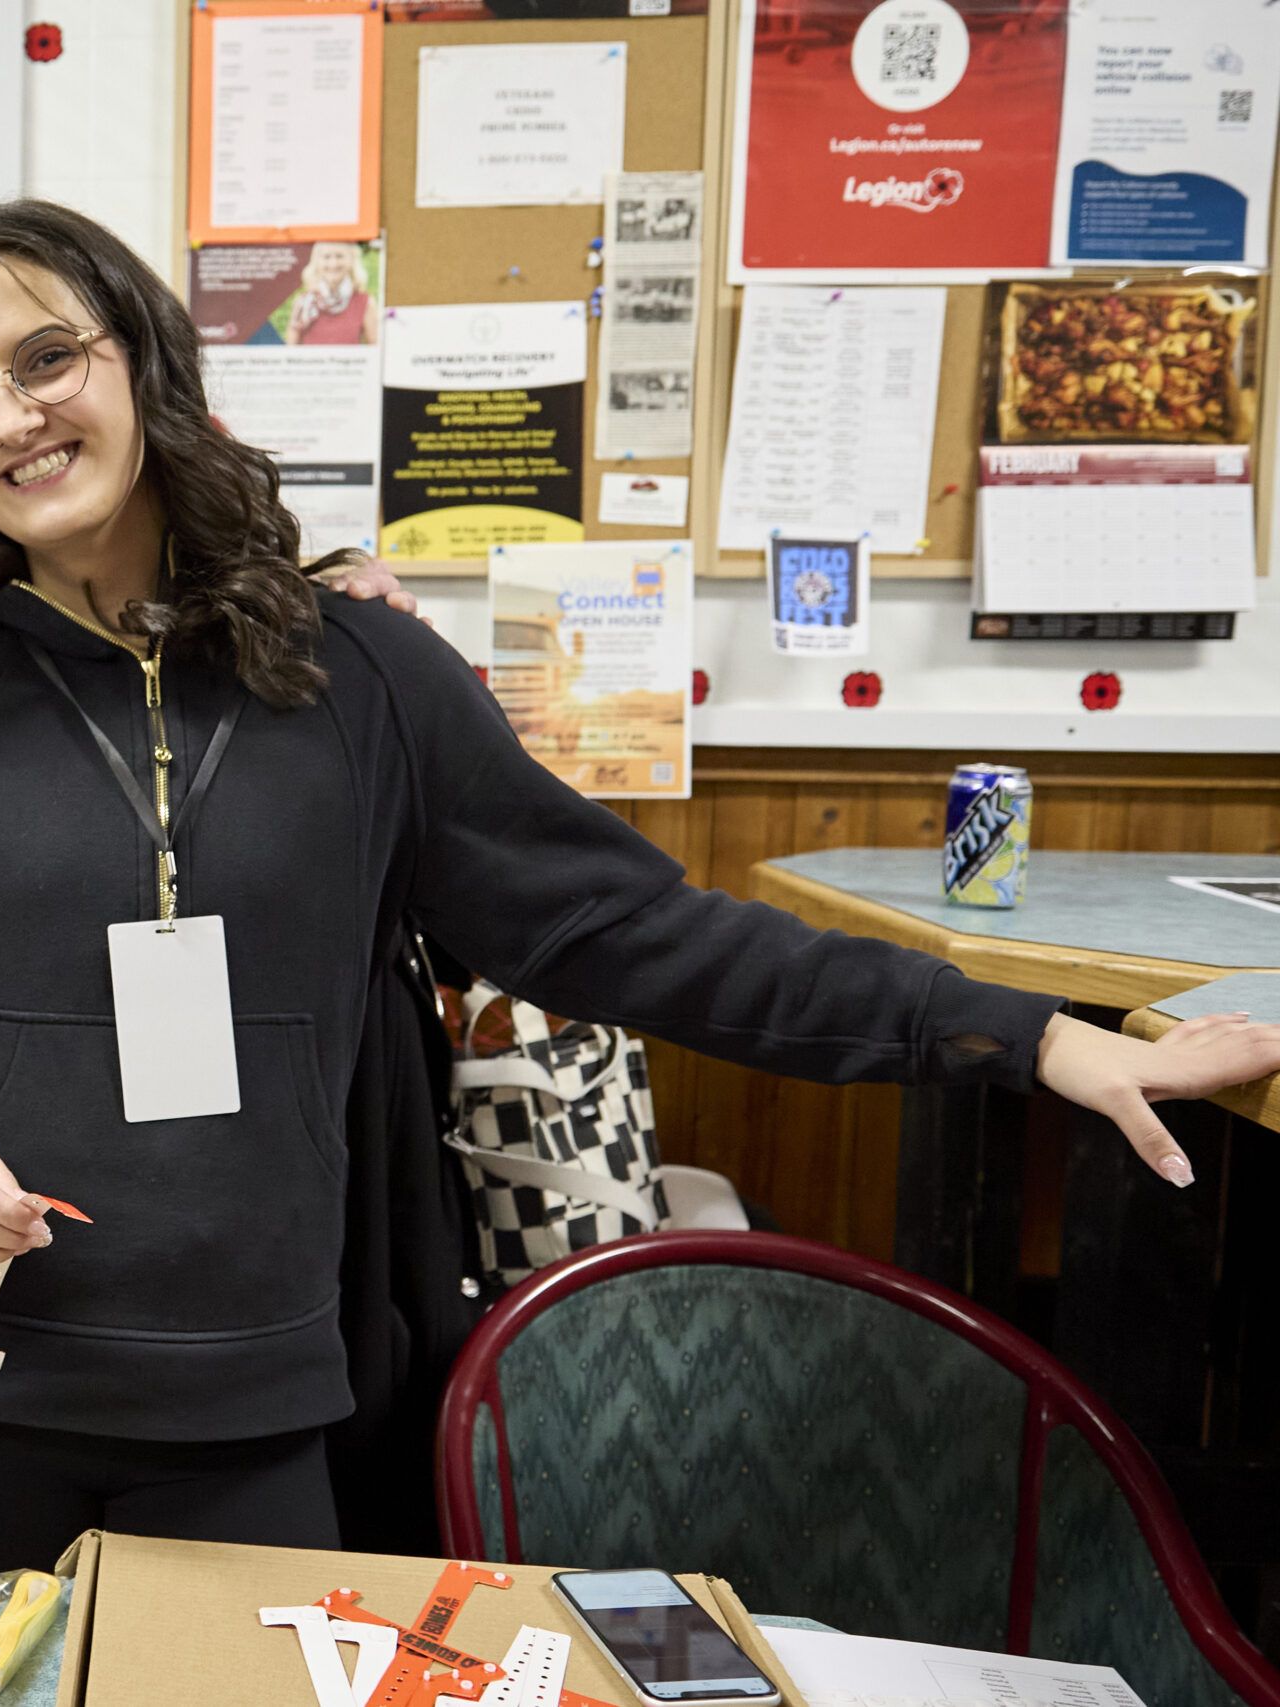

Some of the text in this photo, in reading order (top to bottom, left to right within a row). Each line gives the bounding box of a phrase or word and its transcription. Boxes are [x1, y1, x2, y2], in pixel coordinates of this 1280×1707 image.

[843, 176, 924, 207] Legion
[780, 547, 850, 574] COLD
[557, 590, 665, 611] Connect
[420, 1605, 454, 1635] BONES
[401, 1632, 462, 1663] BONES
